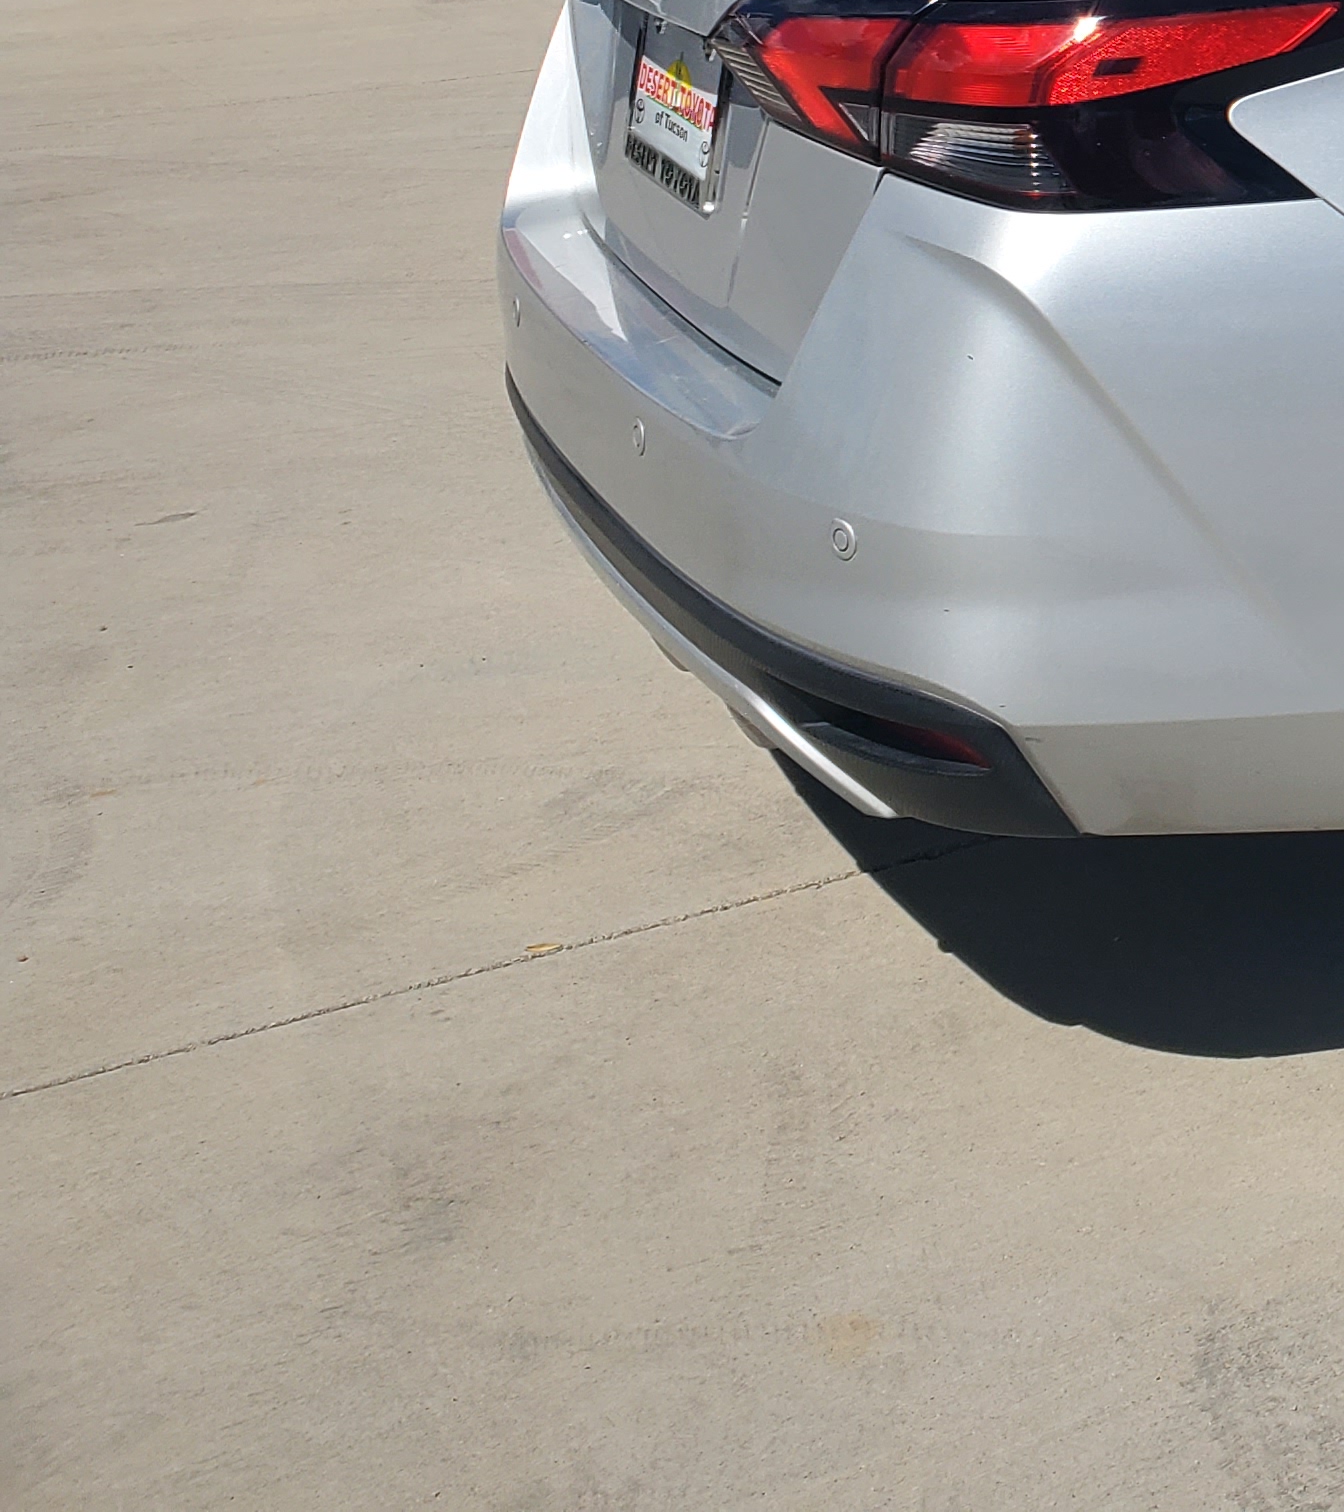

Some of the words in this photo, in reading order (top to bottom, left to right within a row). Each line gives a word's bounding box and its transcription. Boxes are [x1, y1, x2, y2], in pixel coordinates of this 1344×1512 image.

[637, 62, 678, 109] DESERT
[678, 84, 718, 131] TOYOTA
[655, 112, 664, 127] of
[664, 113, 688, 143] Tucson
